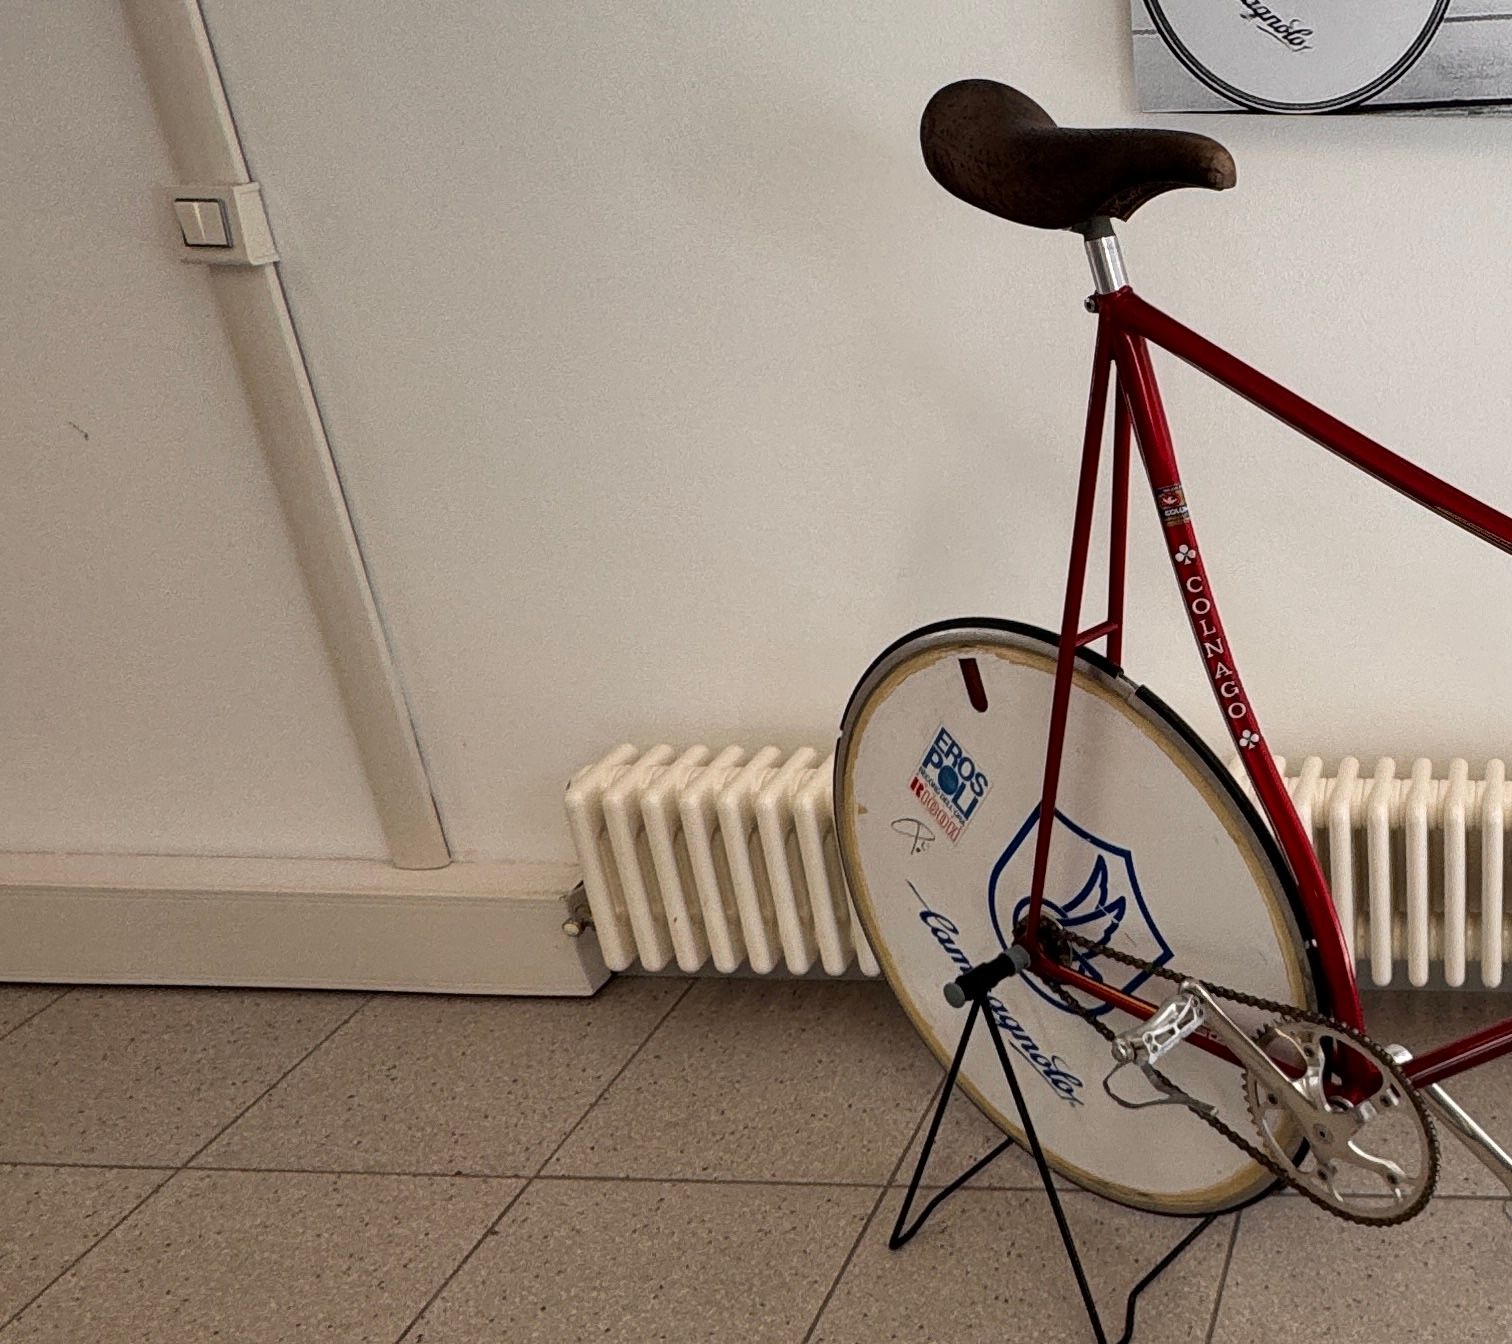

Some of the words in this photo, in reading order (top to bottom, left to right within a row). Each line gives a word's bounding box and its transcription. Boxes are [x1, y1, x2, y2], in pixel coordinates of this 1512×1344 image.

[1186, 576, 1247, 719] COLNAGO
[922, 744, 979, 821] POLI
[934, 727, 988, 797] EROS
